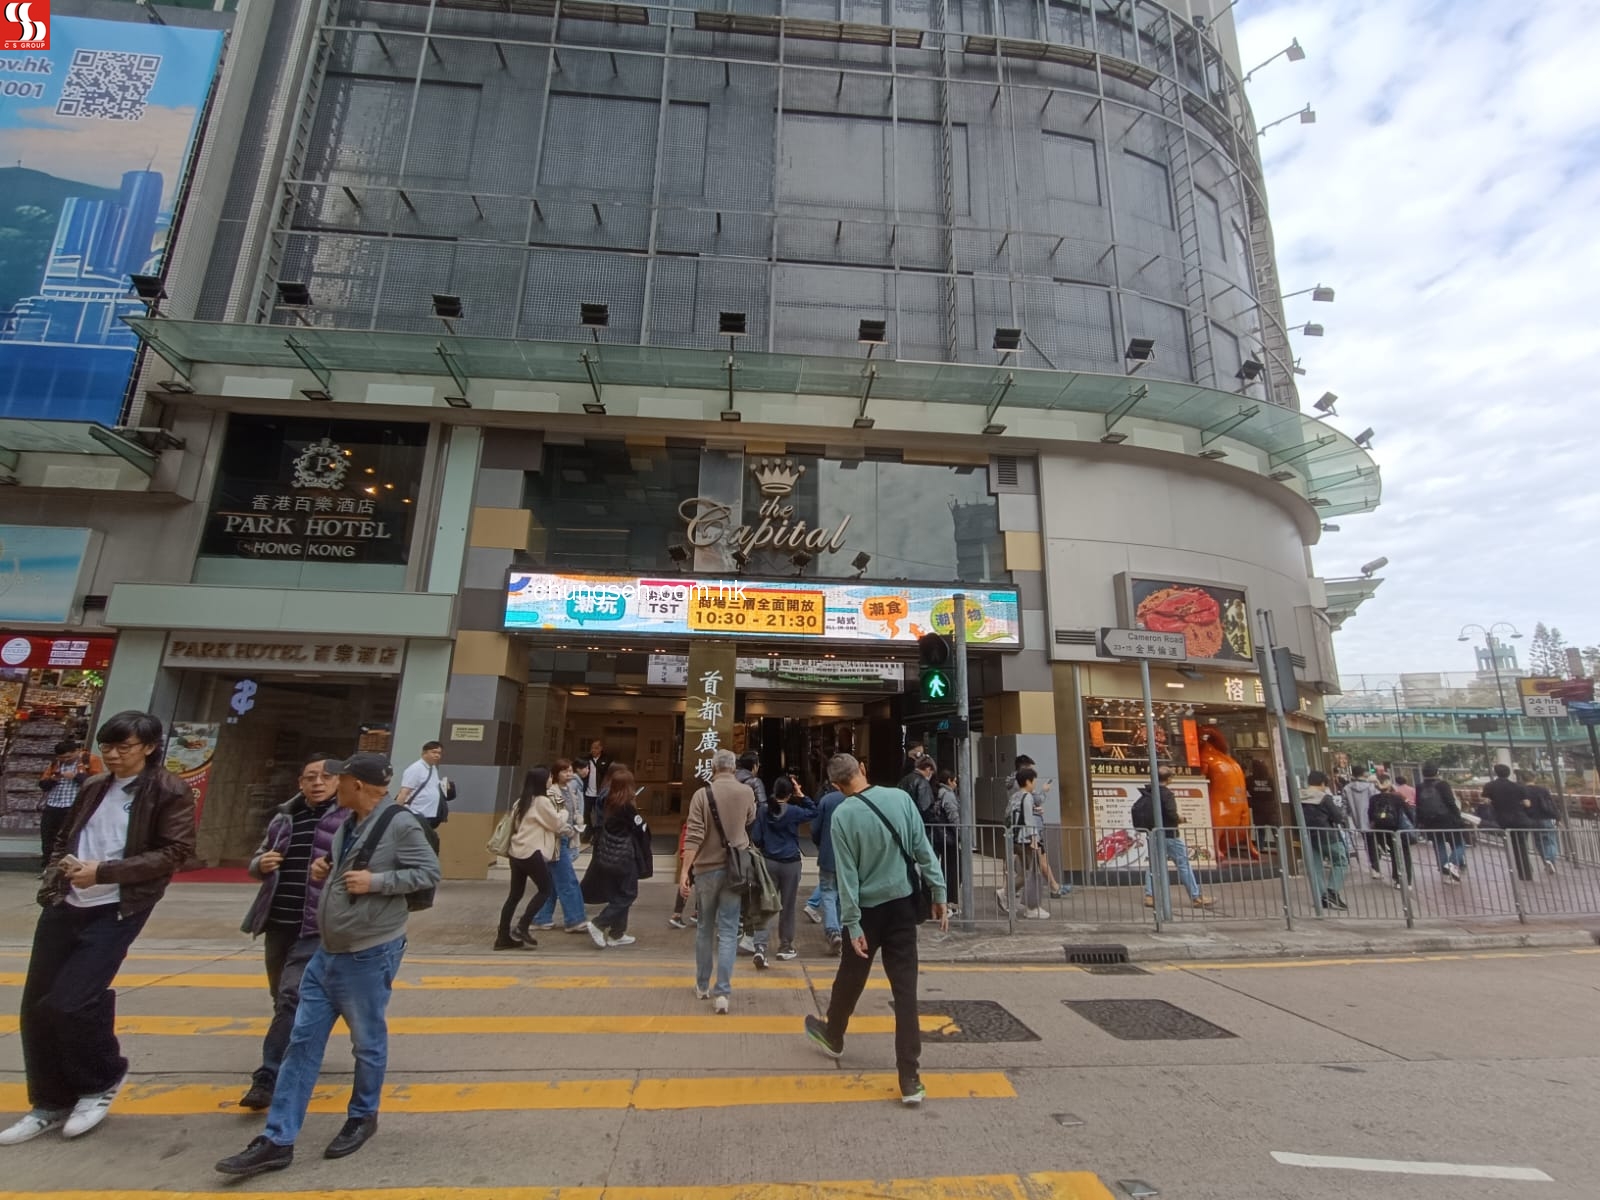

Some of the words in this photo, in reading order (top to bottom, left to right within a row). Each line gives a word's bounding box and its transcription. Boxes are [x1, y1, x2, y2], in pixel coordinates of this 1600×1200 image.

[315, 456, 329, 472] P
[252, 494, 376, 514] 香港百樂酒店
[759, 496, 794, 517] the
[224, 515, 295, 534] PARK
[304, 519, 391, 539] HOTEL
[678, 497, 851, 557] Capital
[253, 542, 301, 556] HONG
[308, 544, 356, 557] KONG
[649, 603, 679, 614] TST
[698, 597, 815, 613] 商場三層全面開放
[869, 601, 902, 616] 潮食
[696, 611, 746, 625] 10:30
[766, 614, 817, 628] 21:30
[827, 616, 856, 625] 一站式
[935, 609, 982, 626] 潮物
[1127, 632, 1162, 642] Cameron
[1164, 635, 1184, 643] Road
[168, 641, 232, 658] PARK
[235, 643, 308, 661] HOTEL
[314, 644, 398, 664] 百樂酒店
[1136, 644, 1177, 656] 金馬倫道
[1528, 697, 1542, 705] 24
[1544, 697, 1561, 705] hrs
[1534, 705, 1558, 715] 全日
